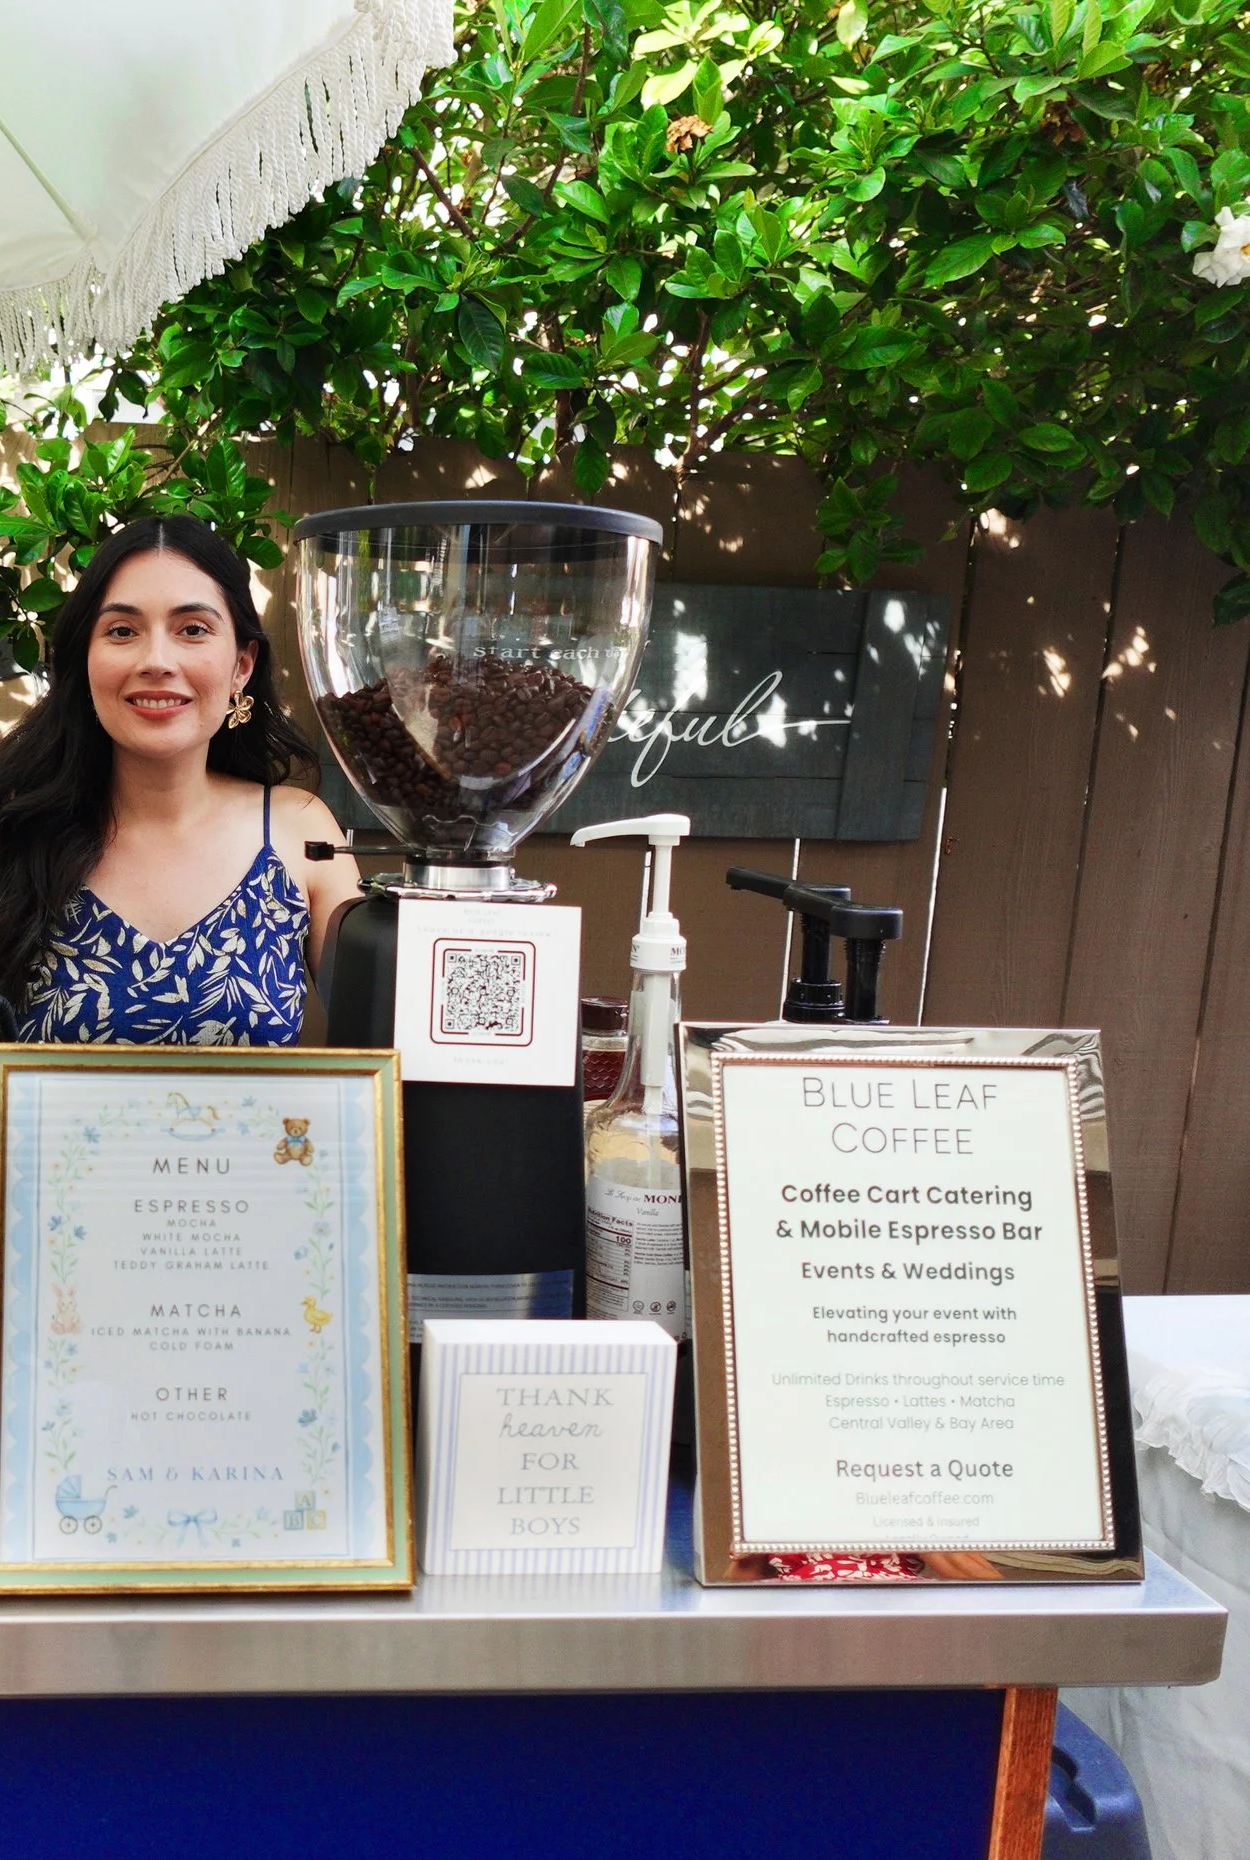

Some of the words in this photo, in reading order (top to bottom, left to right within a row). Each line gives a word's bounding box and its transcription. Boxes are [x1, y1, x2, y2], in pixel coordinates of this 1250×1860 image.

[473, 645, 541, 659] start
[550, 646, 600, 660] each
[152, 1156, 230, 1175] MENU
[133, 1198, 249, 1214] ESPRESSO
[781, 1182, 861, 1204] Coffee
[866, 1185, 921, 1204] Cart
[926, 1184, 1033, 1213] Catering
[165, 1219, 217, 1228] MOCHA
[611, 1216, 633, 1227] Facts
[141, 1232, 182, 1242] WHITE
[190, 1233, 241, 1242] MOCHA
[616, 1236, 631, 1245] 100
[775, 1219, 794, 1239] &
[800, 1218, 882, 1239] Mobile
[888, 1220, 996, 1246] Espresso
[1002, 1221, 1043, 1241] Bar
[139, 1247, 197, 1256] VANILLA
[203, 1246, 243, 1256] LATTE
[113, 1260, 157, 1270] TEDDY
[164, 1261, 223, 1270] GRAHAM
[229, 1261, 269, 1270] LATTE
[801, 1261, 875, 1280] Events
[881, 1262, 897, 1280] &
[902, 1261, 1015, 1287] Weddings
[149, 1303, 242, 1318] MATCHA
[812, 1305, 889, 1324] Elevating
[892, 1309, 930, 1324] your
[932, 1308, 979, 1319] event
[981, 1306, 1017, 1321] with
[90, 1327, 125, 1336] ICED
[131, 1327, 190, 1337] MATCHA
[197, 1327, 229, 1336] WITH
[236, 1327, 291, 1336] BANANA
[827, 1328, 929, 1343] handcrafted
[933, 1332, 1006, 1348] espresso
[149, 1341, 188, 1351] COLD
[194, 1341, 234, 1350] FOAM
[771, 1372, 842, 1386] Unlimited
[844, 1372, 891, 1387] Drinks
[892, 1373, 975, 1390] throughout
[977, 1372, 1030, 1387] service
[1032, 1372, 1066, 1387] time
[155, 1386, 228, 1402] OTHER
[496, 1387, 615, 1407] THANK
[825, 1394, 891, 1411] Espresso
[902, 1396, 947, 1407] Lattes
[959, 1394, 1016, 1408] Matcha
[130, 1412, 157, 1421] HOT
[165, 1411, 252, 1421] CHOCOLATE
[498, 1411, 602, 1439] heaven
[828, 1416, 884, 1430] Central
[886, 1416, 932, 1433] Valley
[934, 1416, 946, 1430] &
[949, 1416, 977, 1434] Bay
[980, 1416, 1015, 1430] Area
[520, 1451, 580, 1471] FOR
[107, 1466, 154, 1482] SAM
[165, 1466, 179, 1482] &
[191, 1465, 284, 1482] KARINA
[836, 1459, 925, 1483] Request
[930, 1463, 943, 1478] a
[947, 1459, 1014, 1482] Quote
[497, 1485, 594, 1505] LITTLE
[855, 1490, 995, 1506] Blueleafcoffee.com
[510, 1516, 581, 1536] BOYS
[872, 1517, 924, 1527] Licensed
[925, 1516, 935, 1527] &
